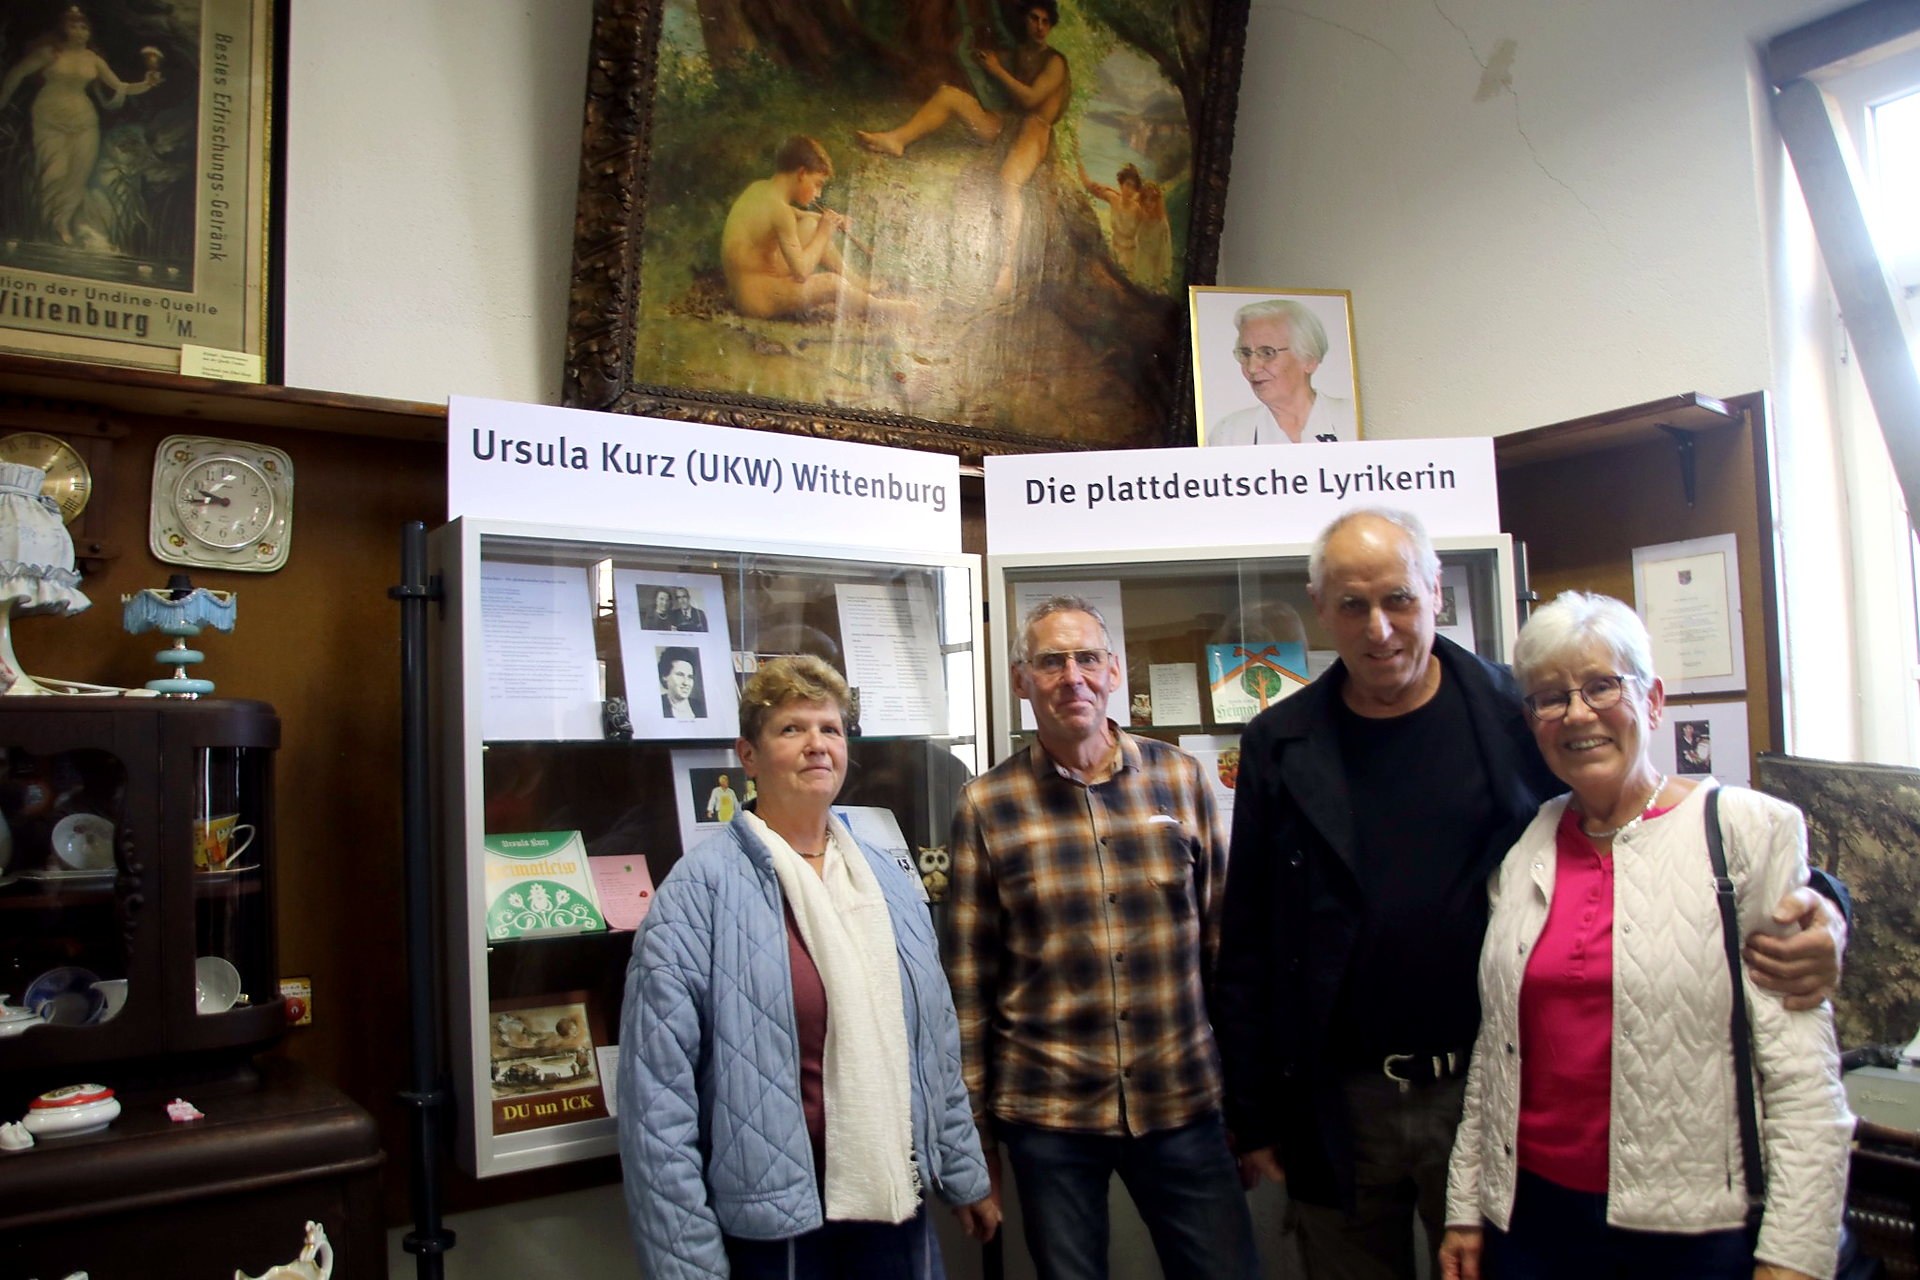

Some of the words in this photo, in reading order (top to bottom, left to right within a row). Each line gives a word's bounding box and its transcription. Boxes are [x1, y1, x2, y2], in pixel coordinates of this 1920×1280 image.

[215, 32, 234, 86] Bestes
[45, 282, 78, 297] der
[85, 287, 218, 315] Undine-Quelle
[472, 428, 588, 470] Ursula
[602, 442, 676, 478] Kurz
[686, 449, 783, 493] (UKW)
[792, 462, 946, 512] Wittenburg
[1025, 476, 1076, 505] Die
[1087, 468, 1309, 510] plattdeutsche
[1319, 462, 1456, 500] Lyrikerin
[503, 1103, 531, 1121] DU
[534, 1102, 558, 1116] un
[561, 1094, 595, 1112] ICK
